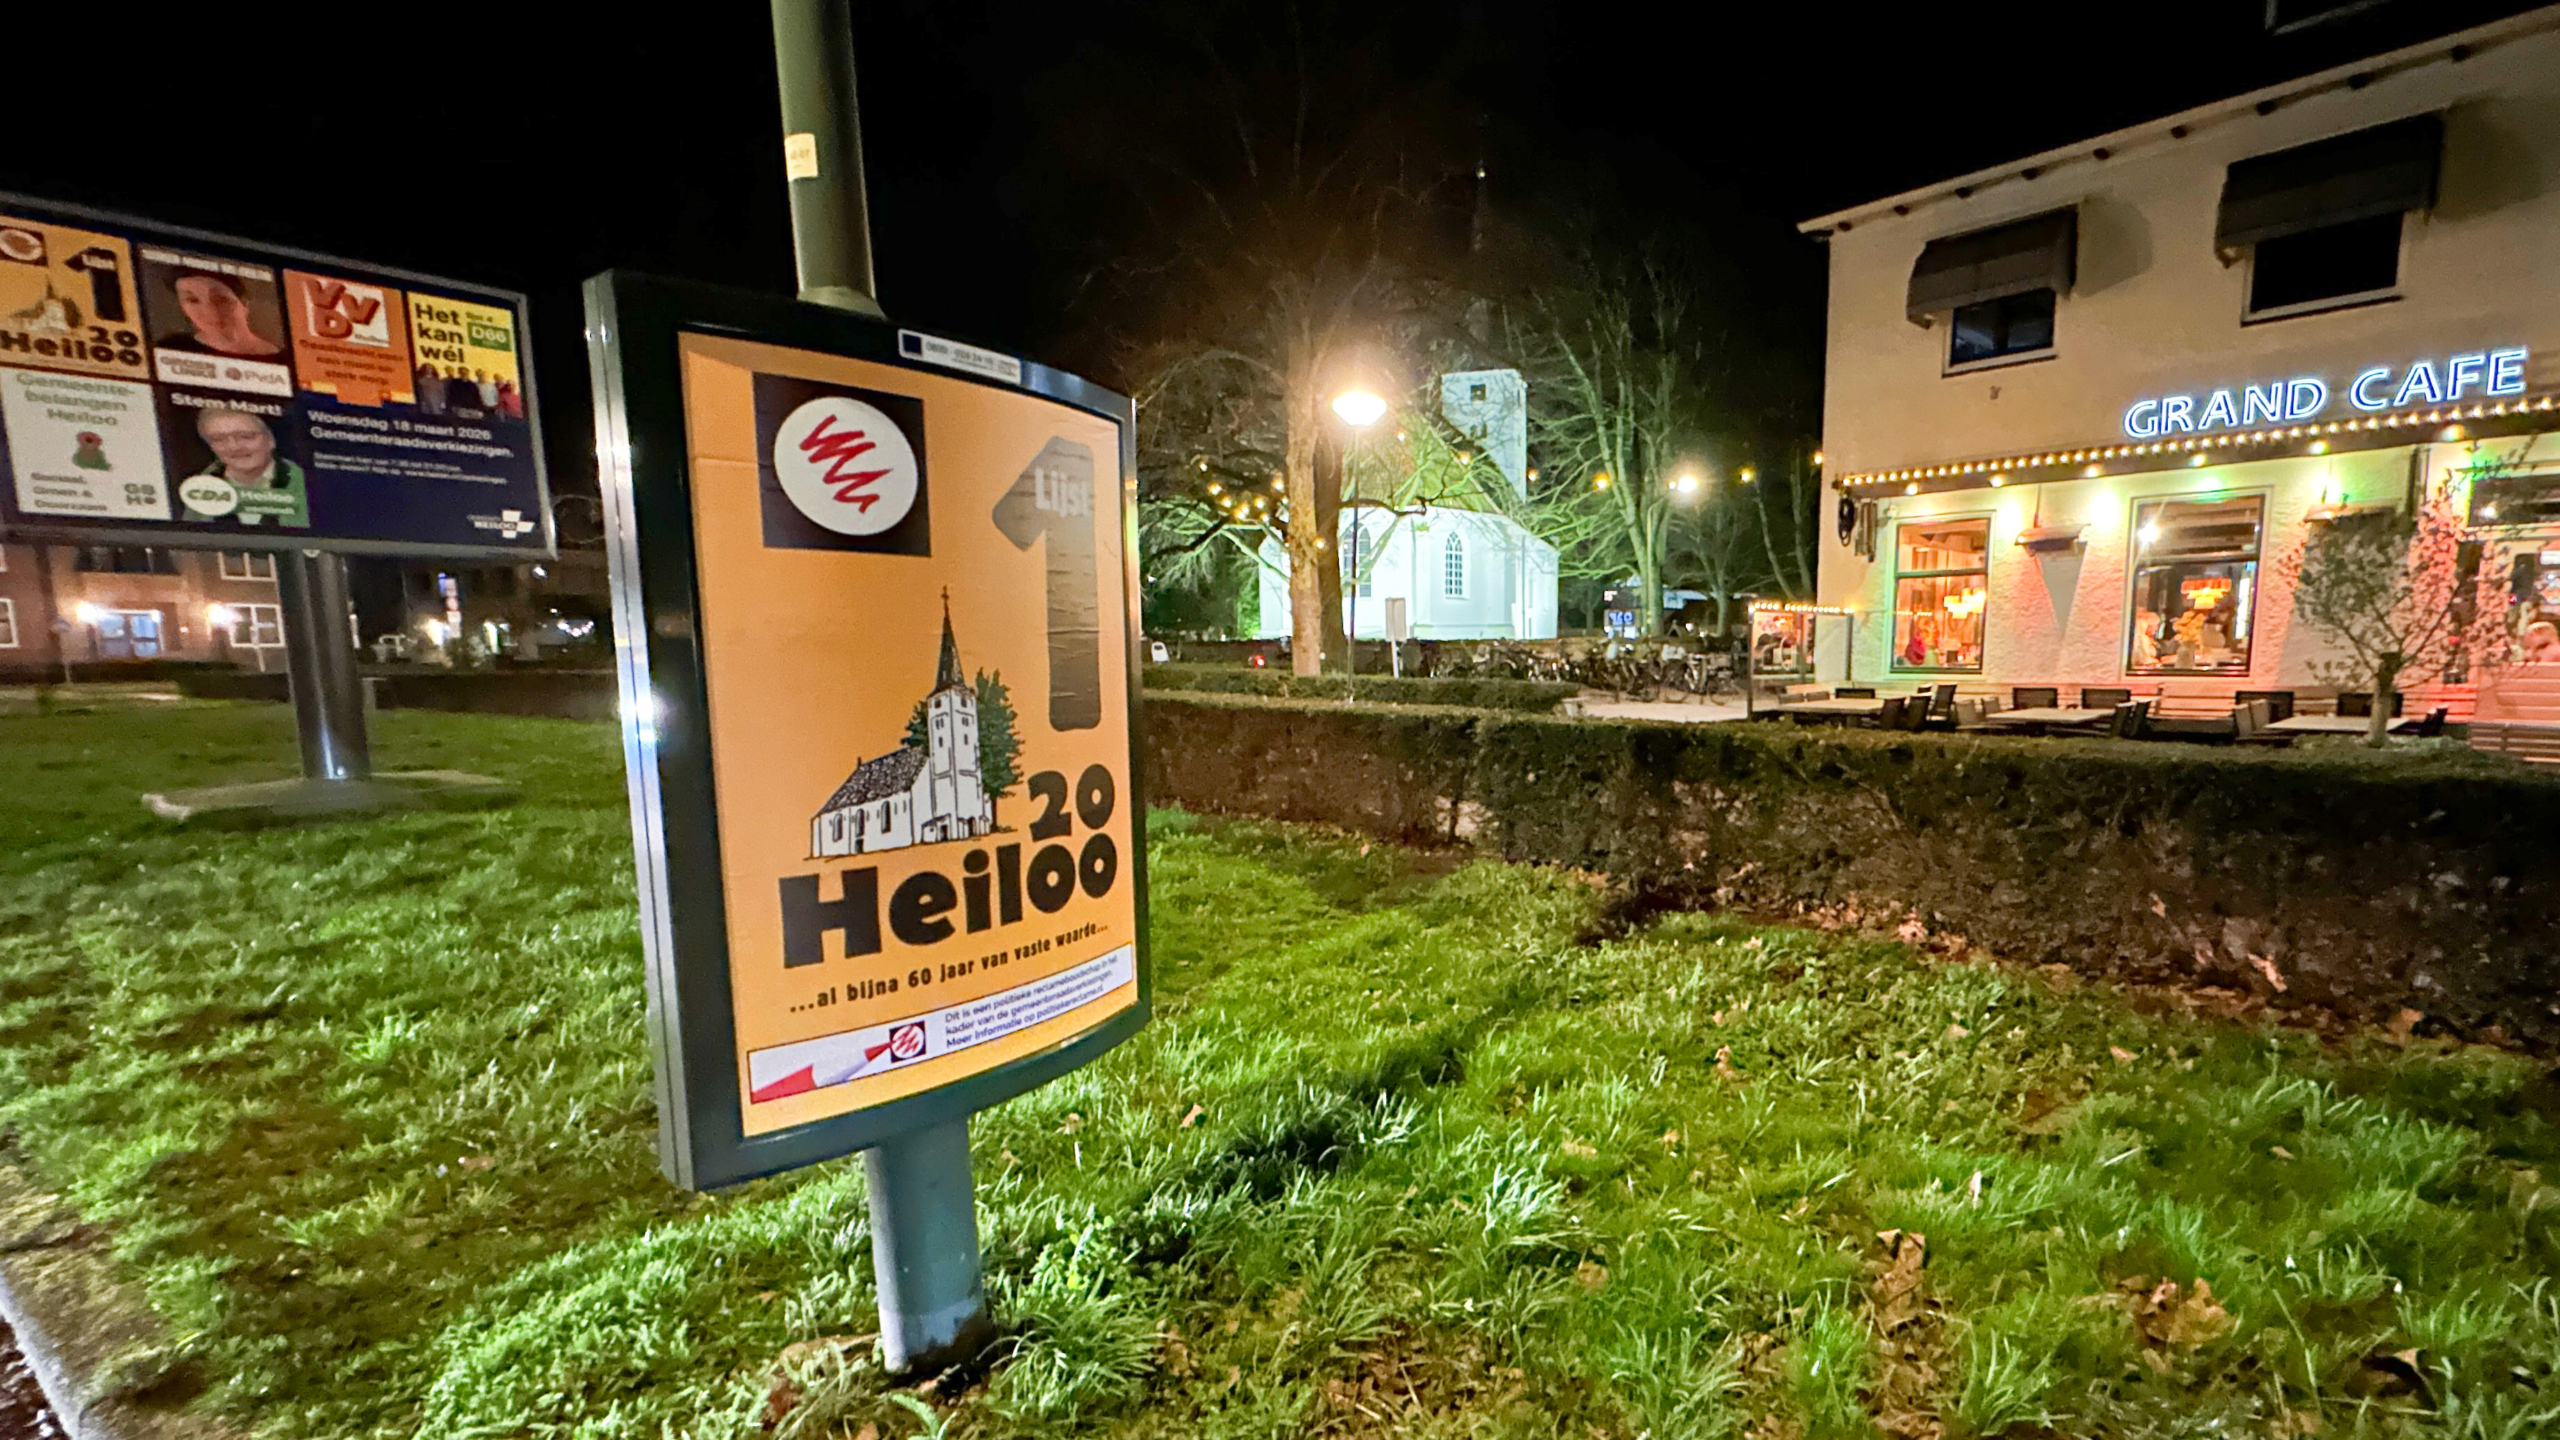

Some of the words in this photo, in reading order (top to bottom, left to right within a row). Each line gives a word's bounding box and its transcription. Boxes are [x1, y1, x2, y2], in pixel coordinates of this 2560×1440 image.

[66, 247, 125, 322] 1
[414, 303, 460, 326] Het
[0, 329, 141, 366] Heiloo
[86, 325, 138, 348] 20
[418, 322, 464, 345] kan
[472, 325, 508, 343] D66
[420, 345, 465, 364] wél
[244, 370, 286, 384] PvdA
[2123, 377, 2328, 439] GRAND
[2350, 345, 2530, 411] CAFE
[171, 392, 225, 409] Stem
[47, 408, 118, 425] Heiloo
[307, 410, 388, 431] Woensdag
[393, 420, 410, 432] 18
[414, 424, 455, 436] maart
[458, 427, 493, 440] 2026
[187, 489, 232, 502] CDA
[1035, 466, 1093, 518] Lijst
[992, 435, 1101, 731] 1
[1027, 763, 1115, 842] 20
[779, 833, 1117, 968] Heiloo
[847, 978, 898, 1001] bijna
[908, 968, 932, 988] 60
[940, 963, 974, 983] jaar
[981, 951, 1008, 970] van
[1014, 939, 1051, 961] vaste
[945, 1011, 960, 1023] Dit
[962, 1010, 971, 1018] is
[973, 1002, 992, 1015] een
[993, 990, 1032, 1011] politieke
[946, 1019, 975, 1035] kader
[977, 1014, 996, 1026] van
[997, 1010, 1009, 1020] de
[946, 1034, 973, 1049] Meer
[1024, 1013, 1036, 1025] op
